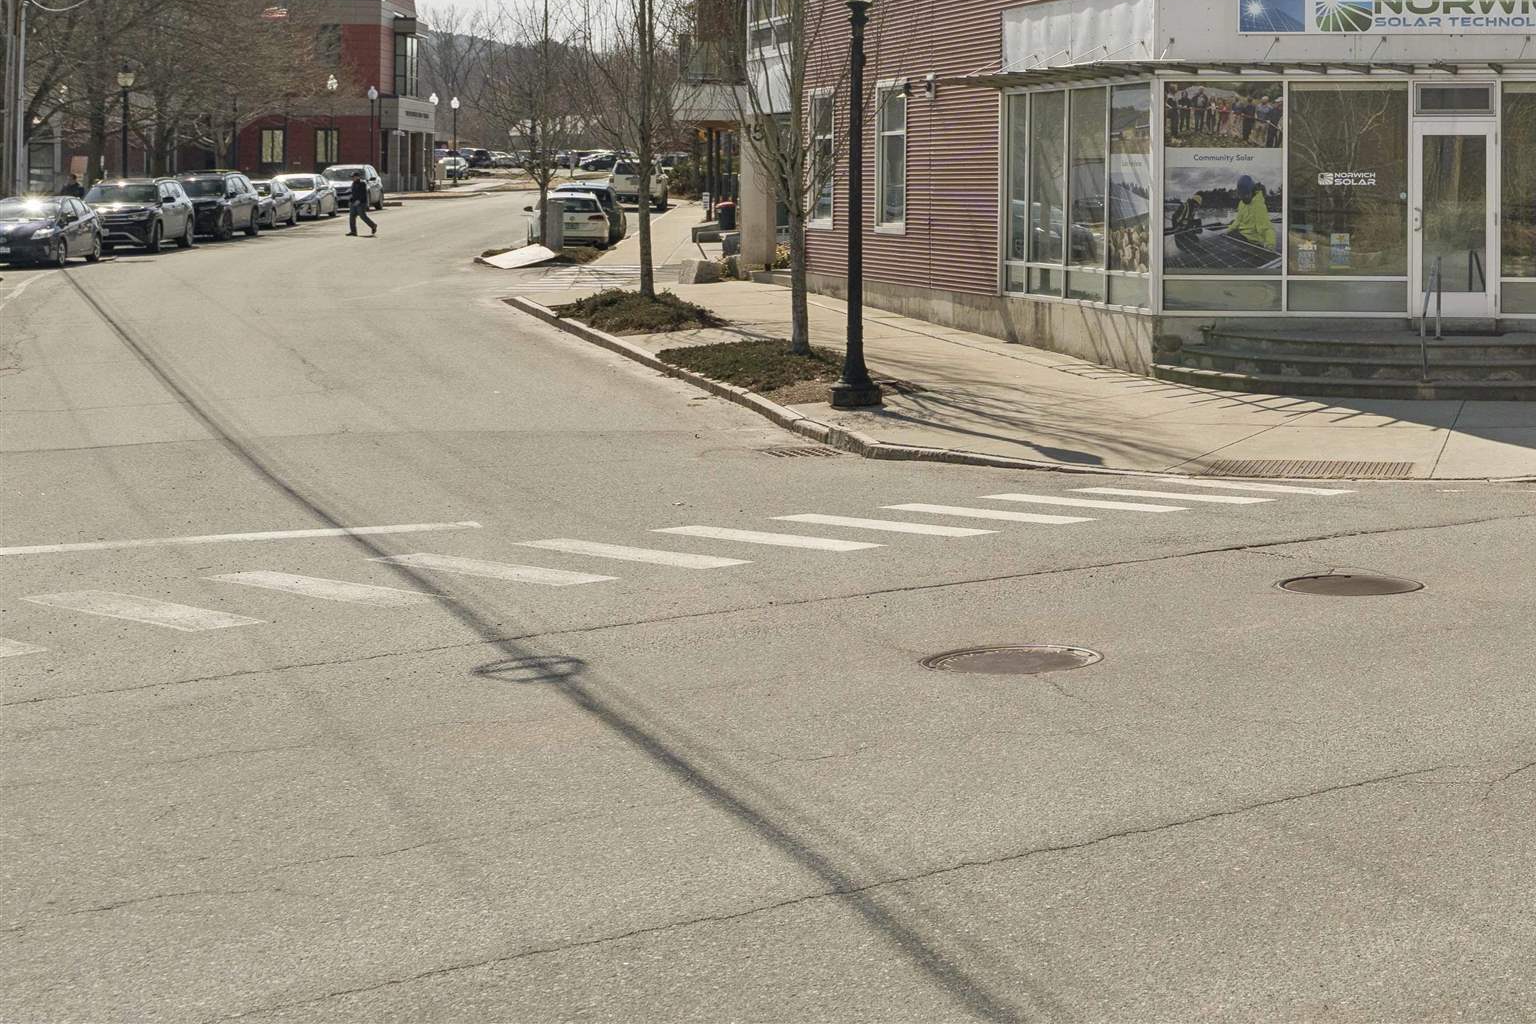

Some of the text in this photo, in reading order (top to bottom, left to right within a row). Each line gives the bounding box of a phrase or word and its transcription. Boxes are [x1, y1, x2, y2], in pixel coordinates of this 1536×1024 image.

[1374, 17, 1441, 27] SOLAR
[1193, 154, 1234, 163] Community
[1334, 178, 1376, 186] SOLAR
